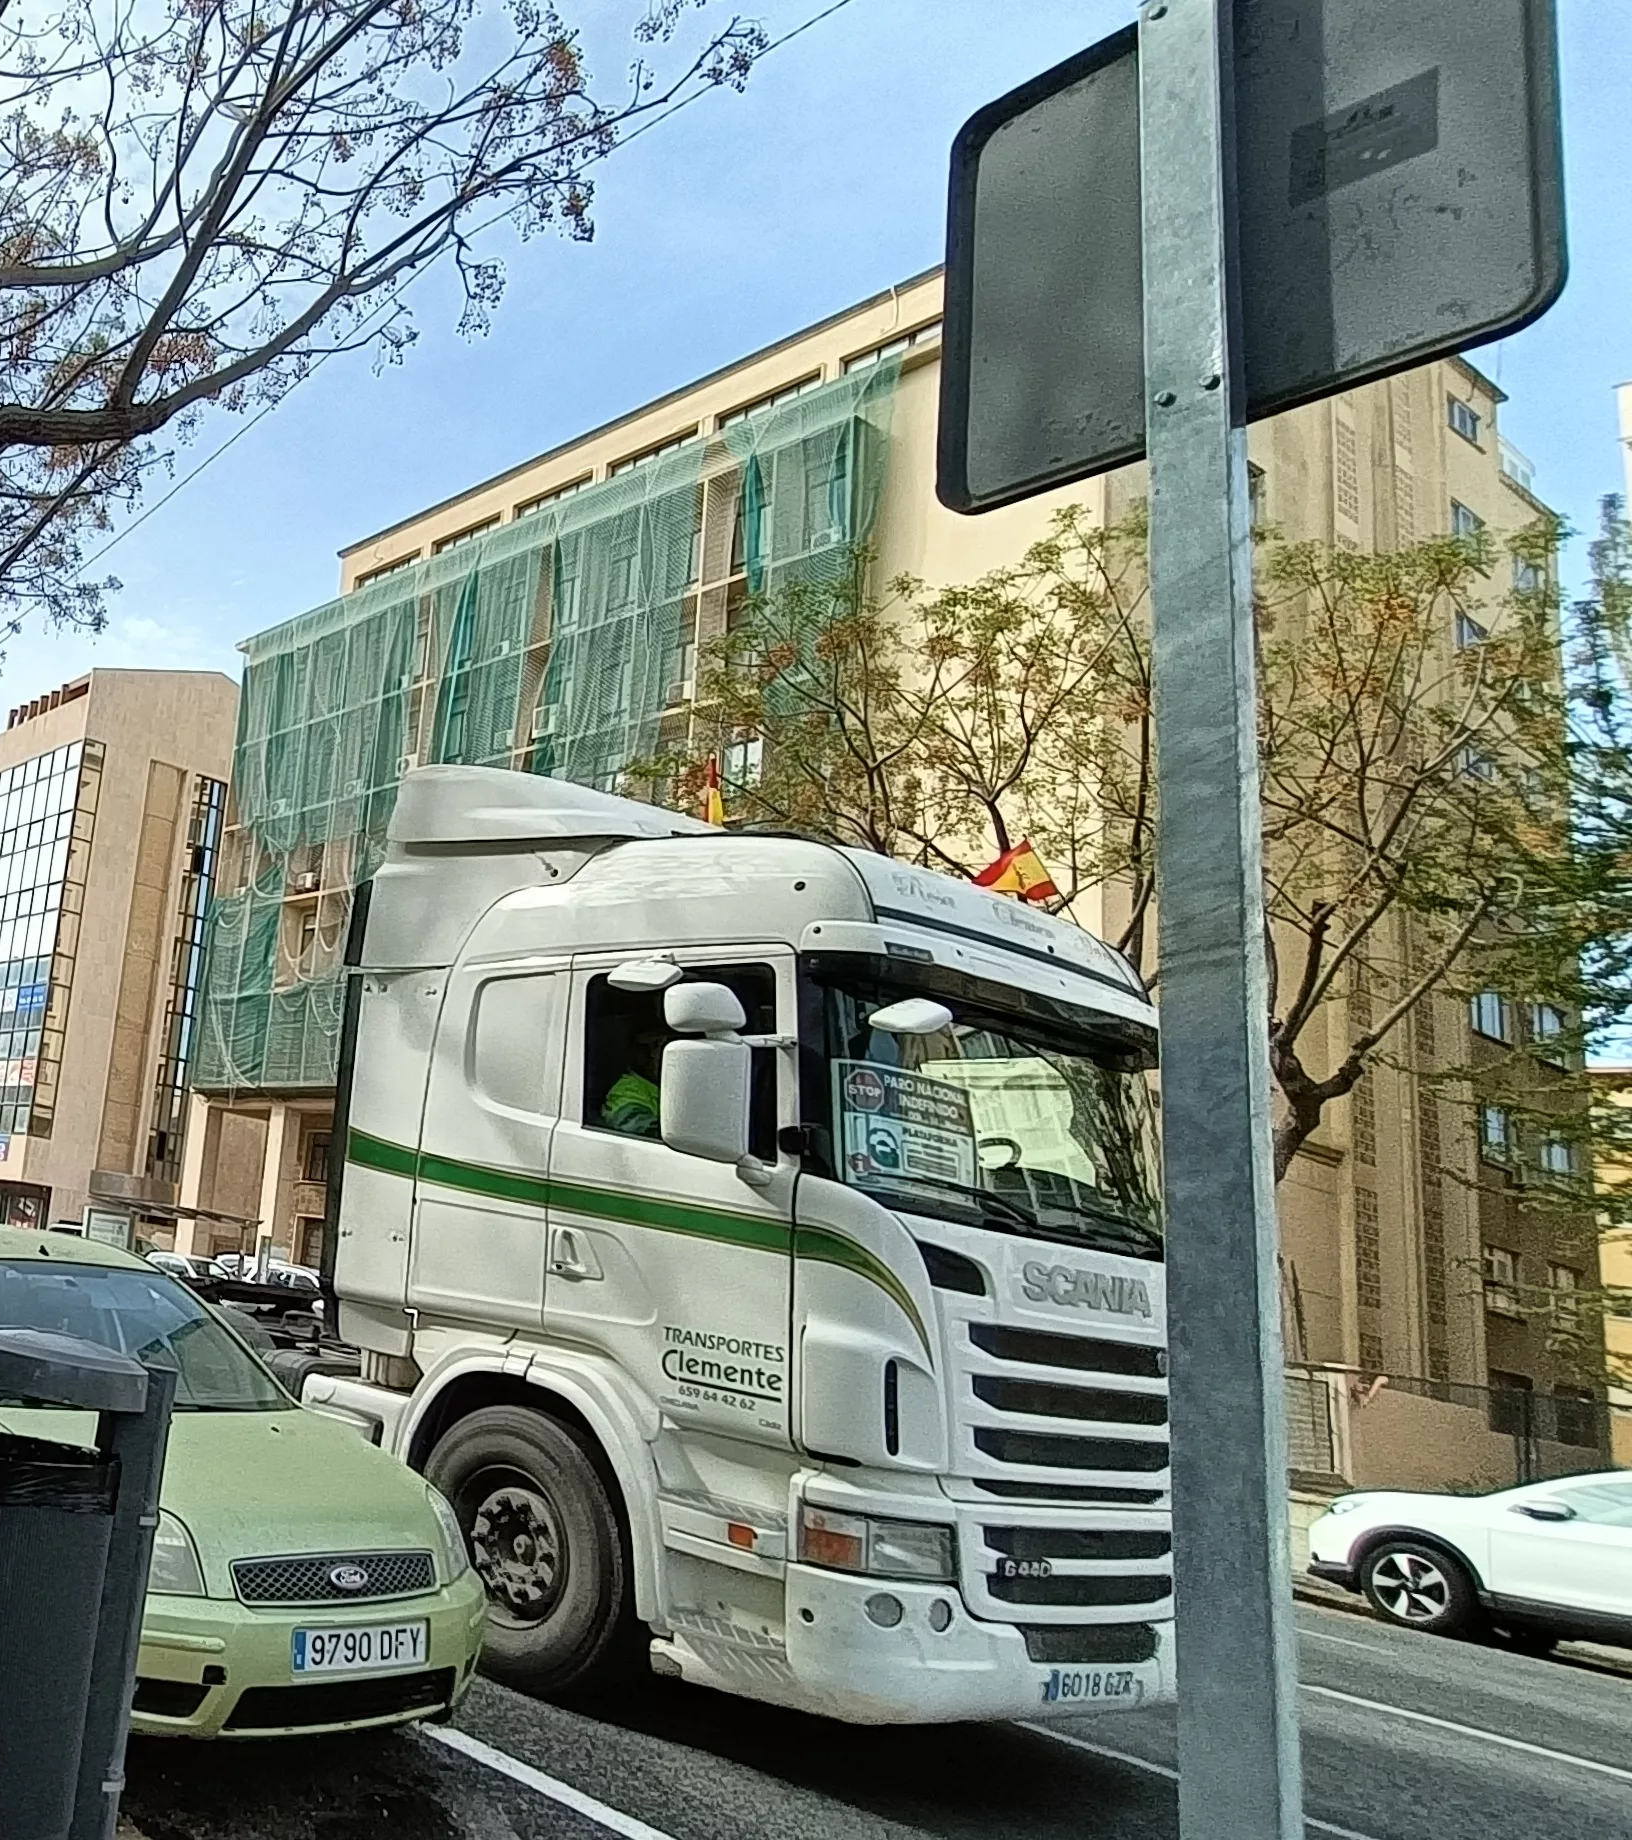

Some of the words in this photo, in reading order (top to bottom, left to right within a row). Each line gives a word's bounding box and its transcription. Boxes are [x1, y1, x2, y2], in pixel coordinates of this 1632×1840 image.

[848, 1084, 882, 1098] STOP
[883, 1074, 915, 1092] PARO
[916, 1080, 968, 1107] NACIONAL
[899, 1093, 959, 1119] INDEFINIDO
[1021, 1260, 1152, 1318] SCANIA
[663, 1326, 785, 1362] TRANSPORTES
[662, 1349, 783, 1391] Clemente
[678, 1385, 701, 1399] 659
[702, 1390, 718, 1403] 64
[721, 1394, 737, 1408] 42
[739, 1398, 756, 1411] 62
[311, 1631, 372, 1666] 9790
[380, 1627, 421, 1661] DFY
[1061, 1672, 1102, 1698] 6018
